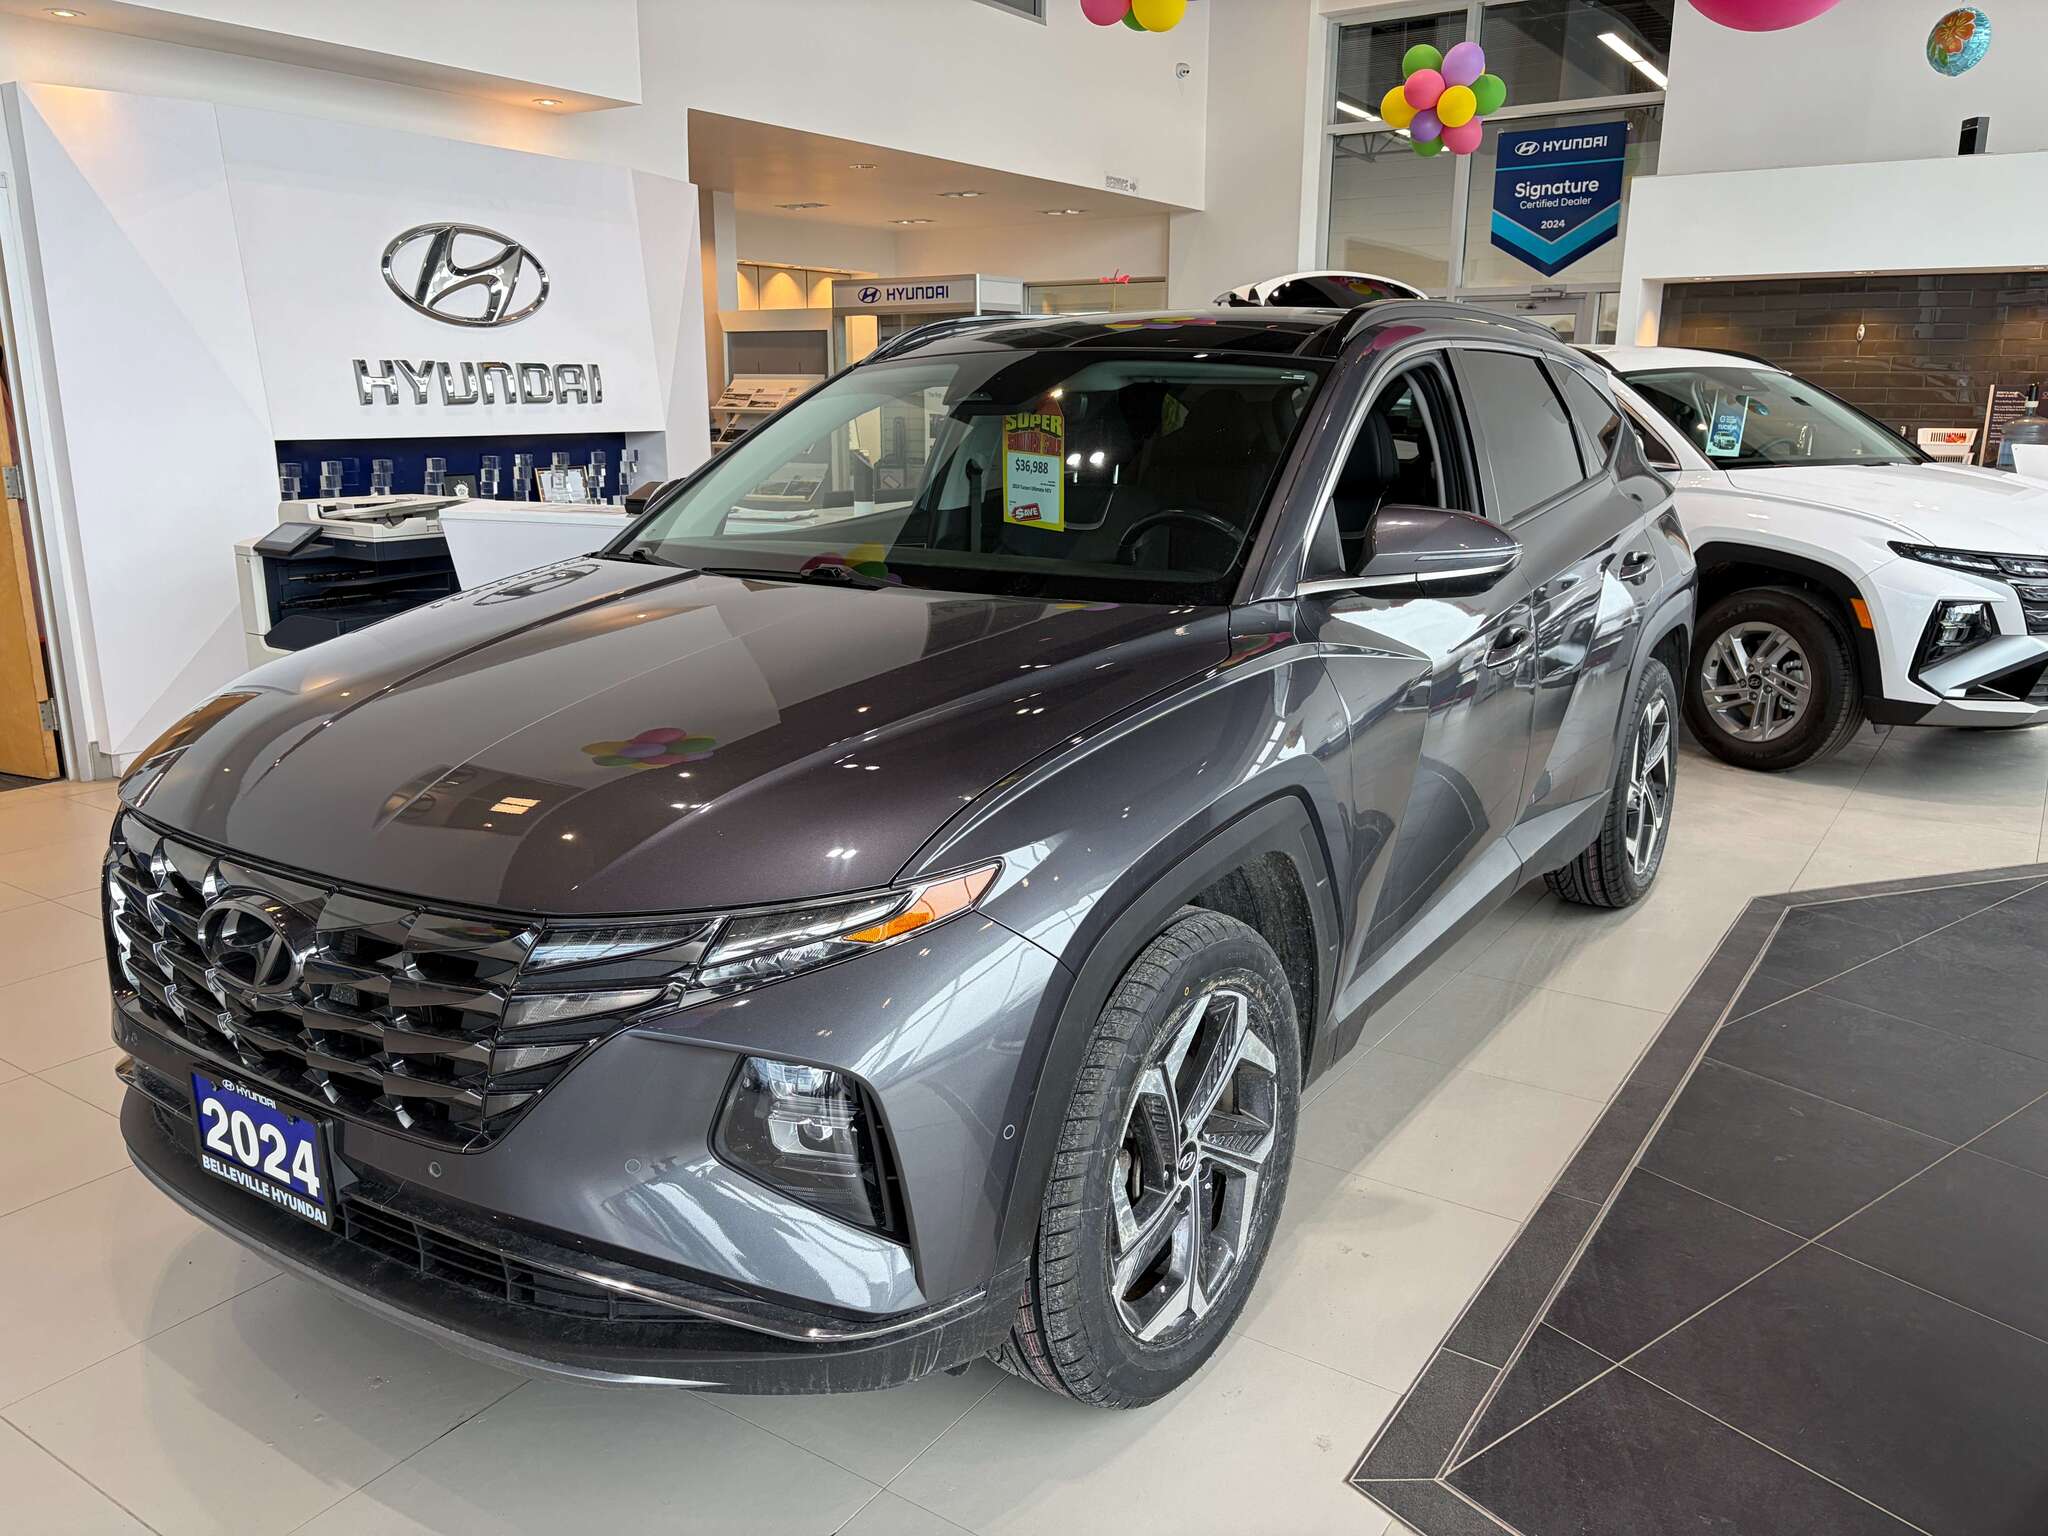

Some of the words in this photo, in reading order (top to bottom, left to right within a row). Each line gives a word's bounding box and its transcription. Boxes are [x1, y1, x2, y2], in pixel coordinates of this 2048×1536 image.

[1542, 135, 1608, 153] HYUNDAI
[1514, 179, 1600, 199] Signature
[1519, 199, 1559, 210] Certified
[1560, 196, 1592, 207] Dealer
[1540, 219, 1565, 230] 2024
[886, 285, 949, 301] HYUNDAI
[352, 359, 603, 406] HYUNDAI
[1007, 412, 1062, 437] SUPER
[1015, 457, 1049, 474] $36,988
[235, 1083, 277, 1110] HYUNDAI
[202, 1097, 320, 1197] 2024
[201, 1154, 270, 1198] BELLEVILLE
[270, 1185, 328, 1226] HYUNDAI
